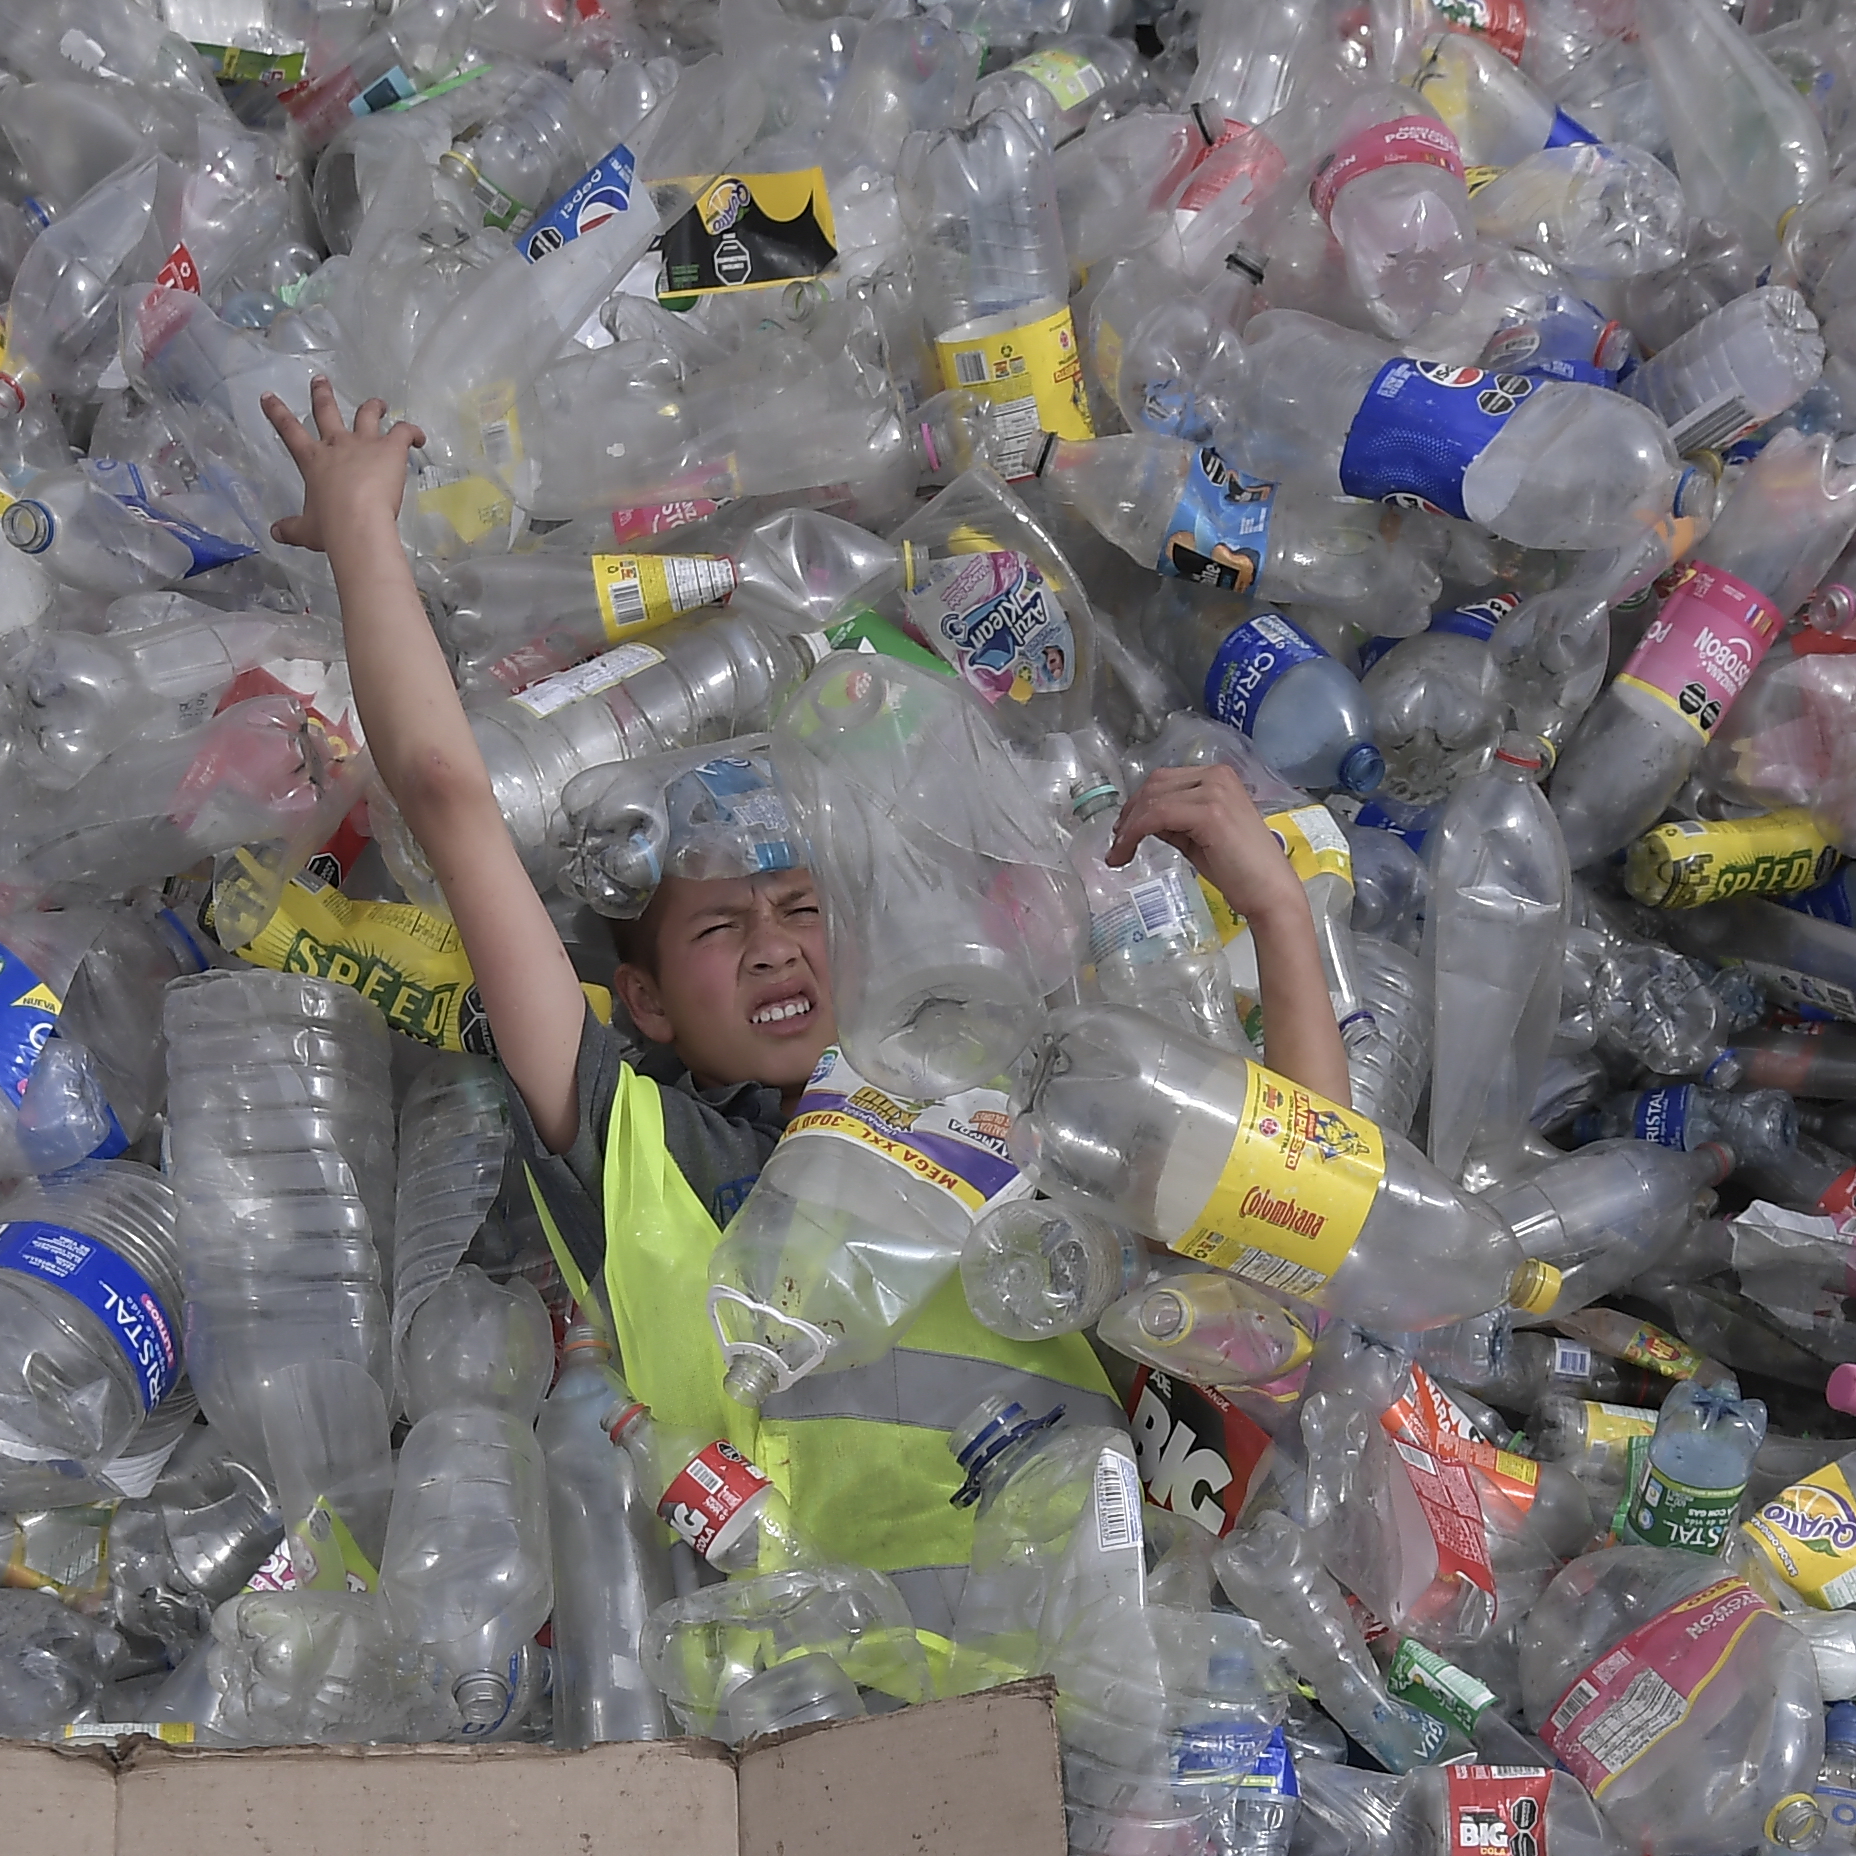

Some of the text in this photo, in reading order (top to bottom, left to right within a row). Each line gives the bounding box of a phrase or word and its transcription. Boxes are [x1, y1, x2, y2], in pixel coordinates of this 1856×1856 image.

[563, 169, 602, 220] pepsi
[966, 594, 1028, 643] Klean
[1711, 848, 1814, 901] SPEED
[289, 929, 464, 1036] SPEED
[859, 1128, 897, 1156] XXL
[901, 1146, 958, 1192] MEGA
[1237, 1186, 1327, 1240] Colombiana
[1459, 1816, 1509, 1848] BIG
[1479, 1846, 1506, 1856] COLA
